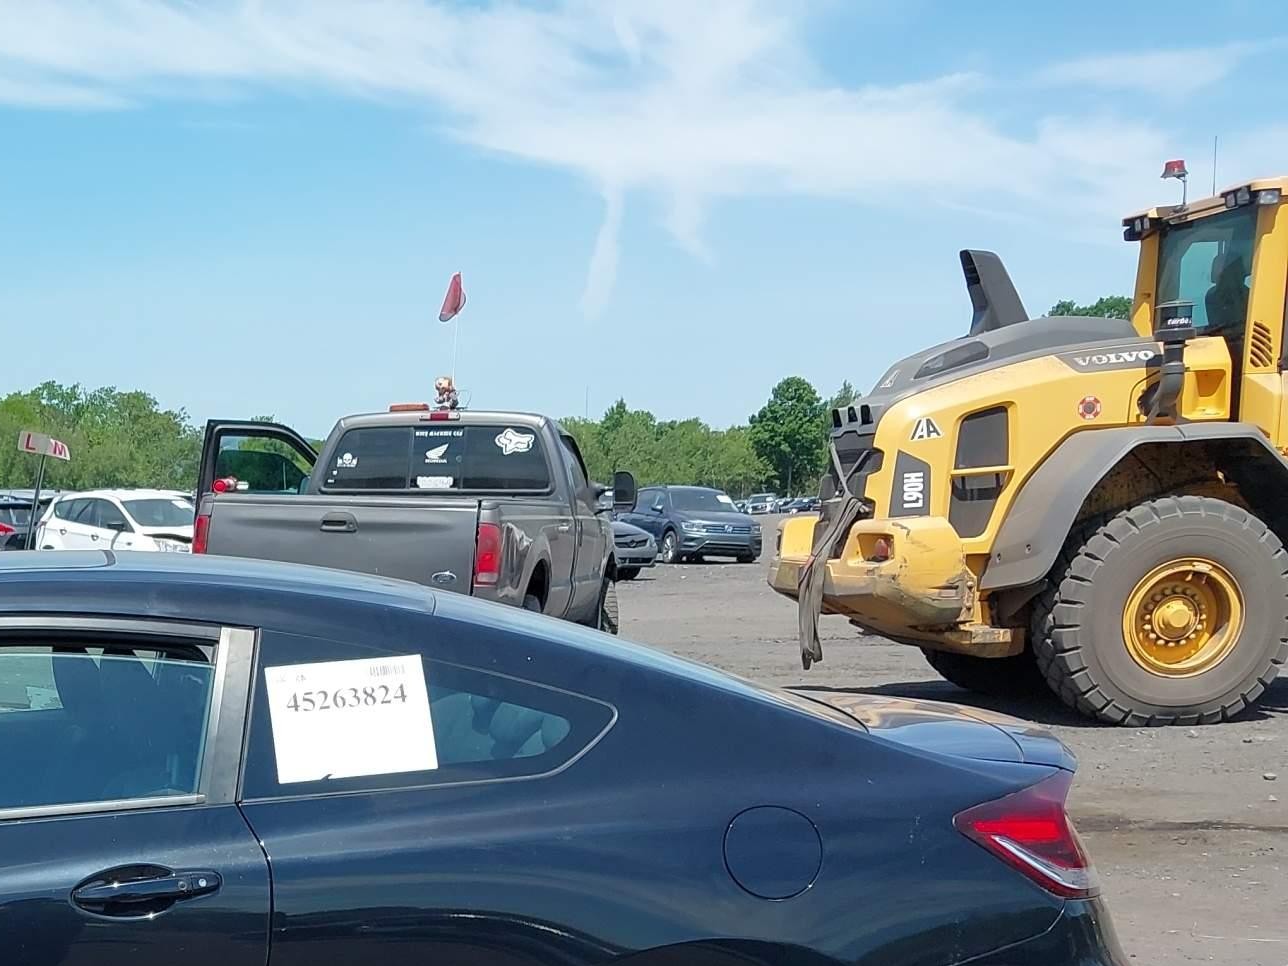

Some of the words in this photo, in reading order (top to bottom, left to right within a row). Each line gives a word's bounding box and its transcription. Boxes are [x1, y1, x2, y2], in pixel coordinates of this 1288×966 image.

[1073, 350, 1155, 366] VOLVO
[25, 433, 36, 450] L
[53, 441, 67, 457] M
[903, 472, 924, 509] L90H
[286, 683, 407, 712] 45263824
